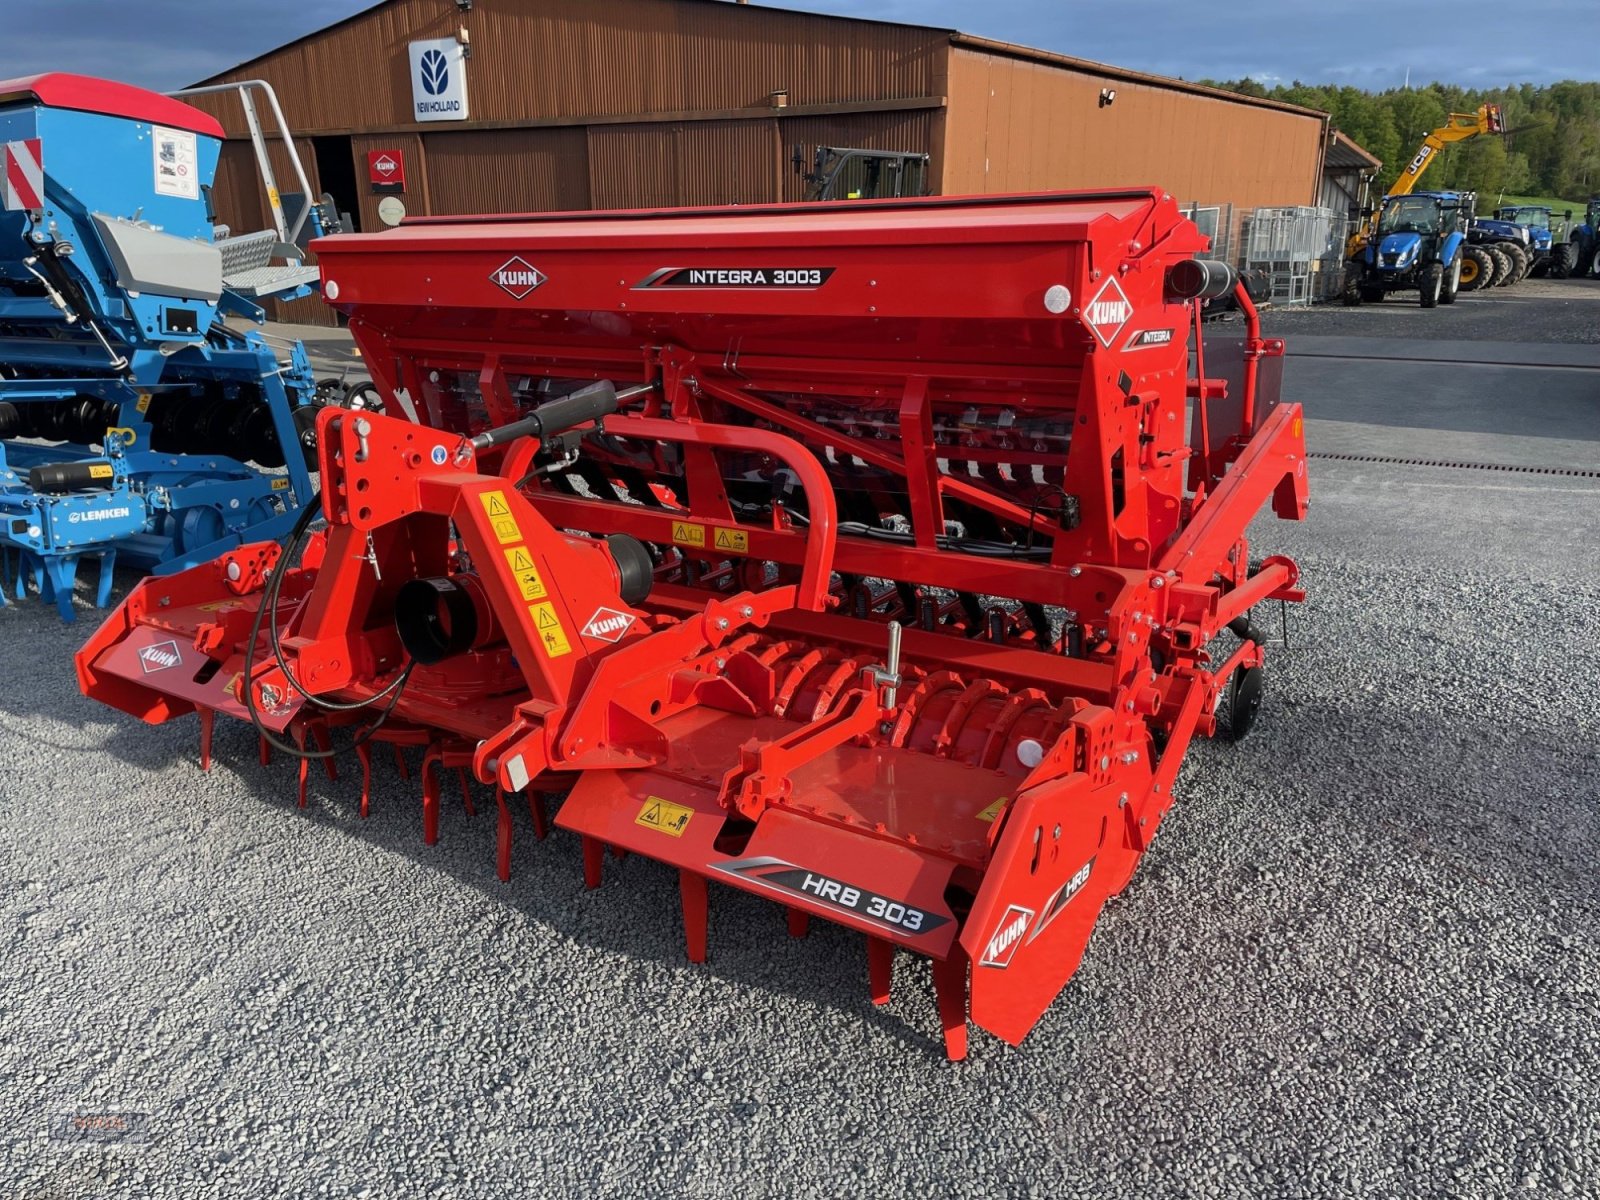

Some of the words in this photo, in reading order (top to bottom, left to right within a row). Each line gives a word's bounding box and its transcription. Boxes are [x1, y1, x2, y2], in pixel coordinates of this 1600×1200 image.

[430, 100, 460, 112] HOLLAND
[1410, 145, 1432, 175] JCB
[498, 271, 538, 286] KUHN
[689, 270, 767, 284] INTEGRA
[773, 270, 821, 284] 3003
[1092, 301, 1126, 325] KUHN
[1143, 330, 1171, 343] INTEGRA
[81, 507, 130, 522] LEMKEN
[590, 614, 628, 637] KUHN
[142, 647, 178, 667] KUHN
[1066, 863, 1091, 898] HRB
[801, 873, 861, 908] HRB
[866, 896, 924, 931] 303
[988, 912, 1027, 962] KUHN
